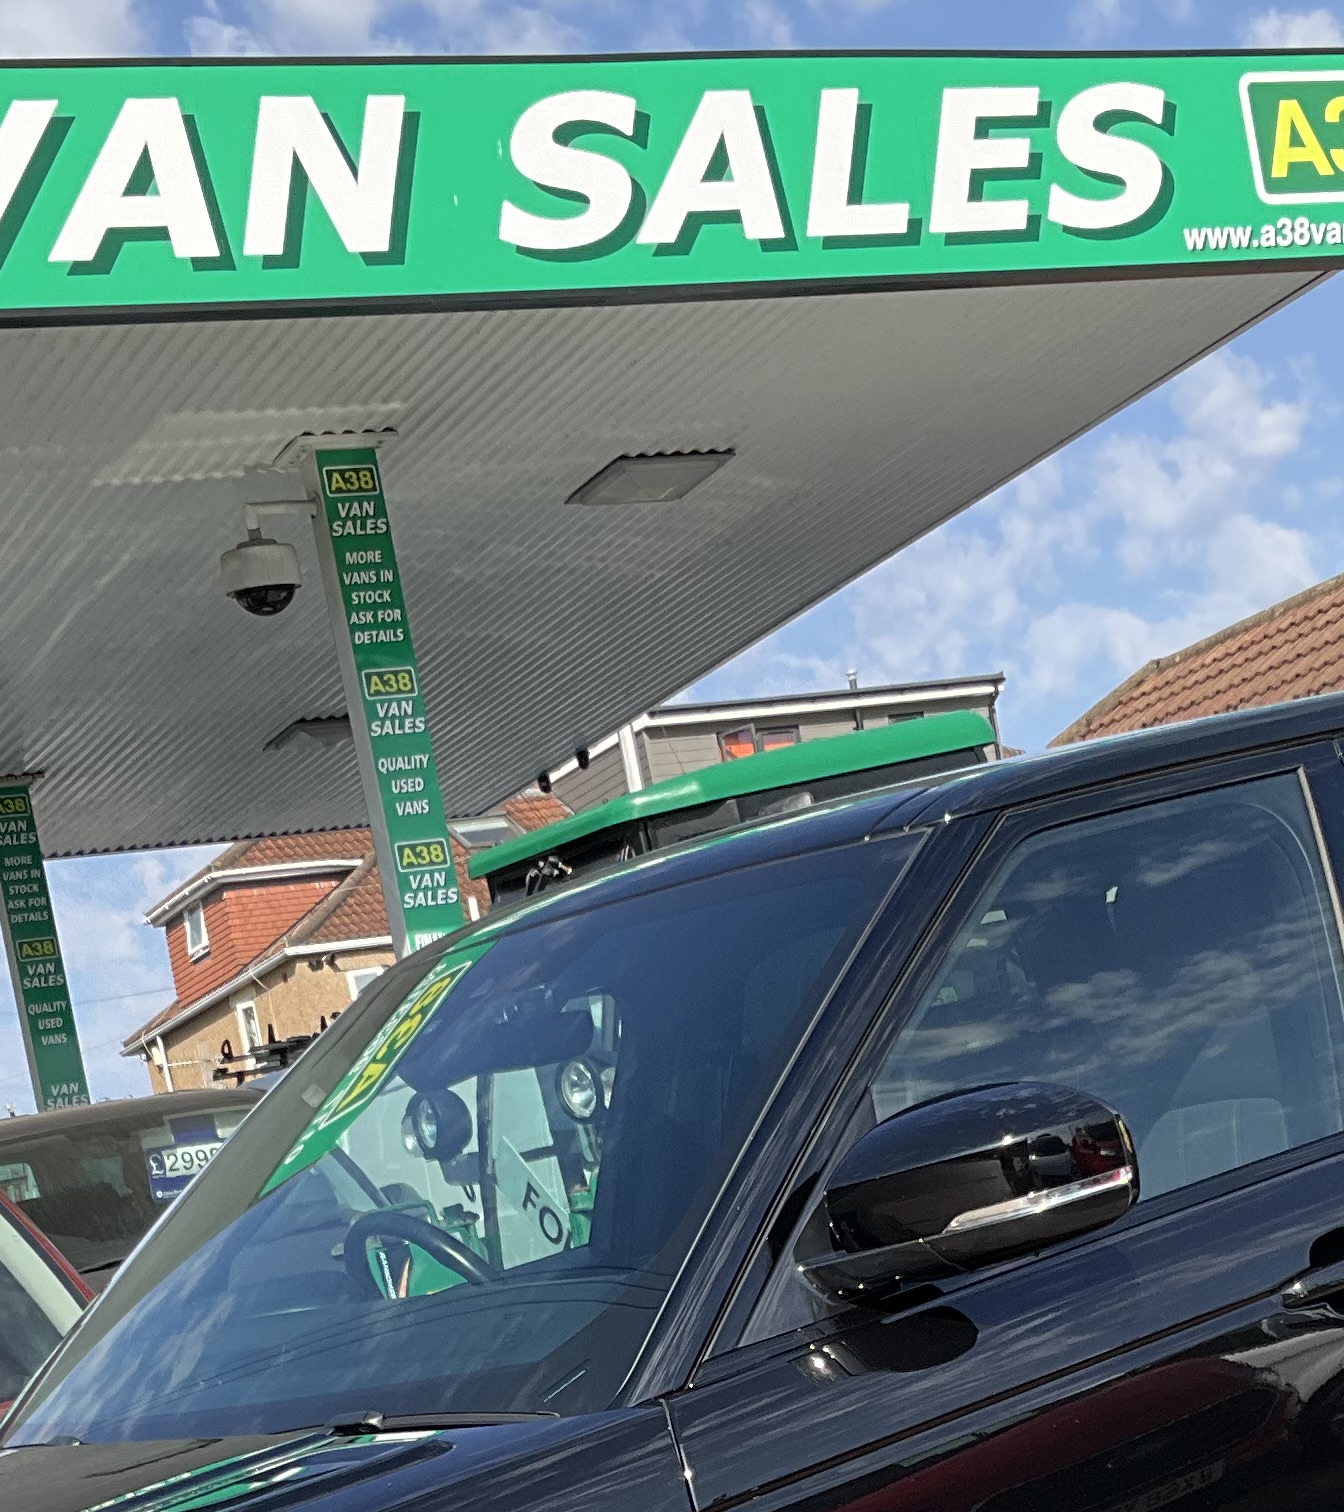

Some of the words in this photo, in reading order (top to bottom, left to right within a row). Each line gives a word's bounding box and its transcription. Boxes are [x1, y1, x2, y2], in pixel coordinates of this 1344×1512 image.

[498, 81, 1170, 251] SALES
[330, 470, 374, 492] A38
[337, 501, 375, 518] VAN
[331, 518, 388, 537] SALES
[345, 550, 382, 565] MORE
[342, 570, 377, 585] VANS
[380, 569, 394, 583] IN
[351, 590, 392, 605] STOCK
[349, 611, 374, 625] ASK
[377, 609, 402, 623] FOR
[354, 629, 404, 645] DETAILS
[369, 672, 413, 694] A38
[376, 700, 413, 717] VAN
[370, 716, 426, 737] SALES
[378, 754, 430, 773] QUALITY
[391, 777, 424, 793] USED
[395, 799, 429, 816] VANS
[4, 855, 33, 867] MORE
[402, 844, 444, 866] A38
[3, 870, 28, 882] VANS
[30, 869, 41, 880] IN
[409, 872, 446, 889] VAN
[9, 883, 39, 896] STOCK
[7, 900, 27, 911] ASK
[29, 897, 47, 909] FOR
[403, 887, 458, 909] SALES
[11, 912, 49, 924] DETAILS
[21, 940, 55, 957] A38
[27, 962, 55, 976] VAN
[23, 974, 65, 989] SALES
[28, 1001, 67, 1016] QUALITY
[38, 1018, 63, 1030] USED
[41, 1033, 67, 1046] VANS
[50, 1082, 79, 1096] VAN
[46, 1094, 89, 1110] SALES
